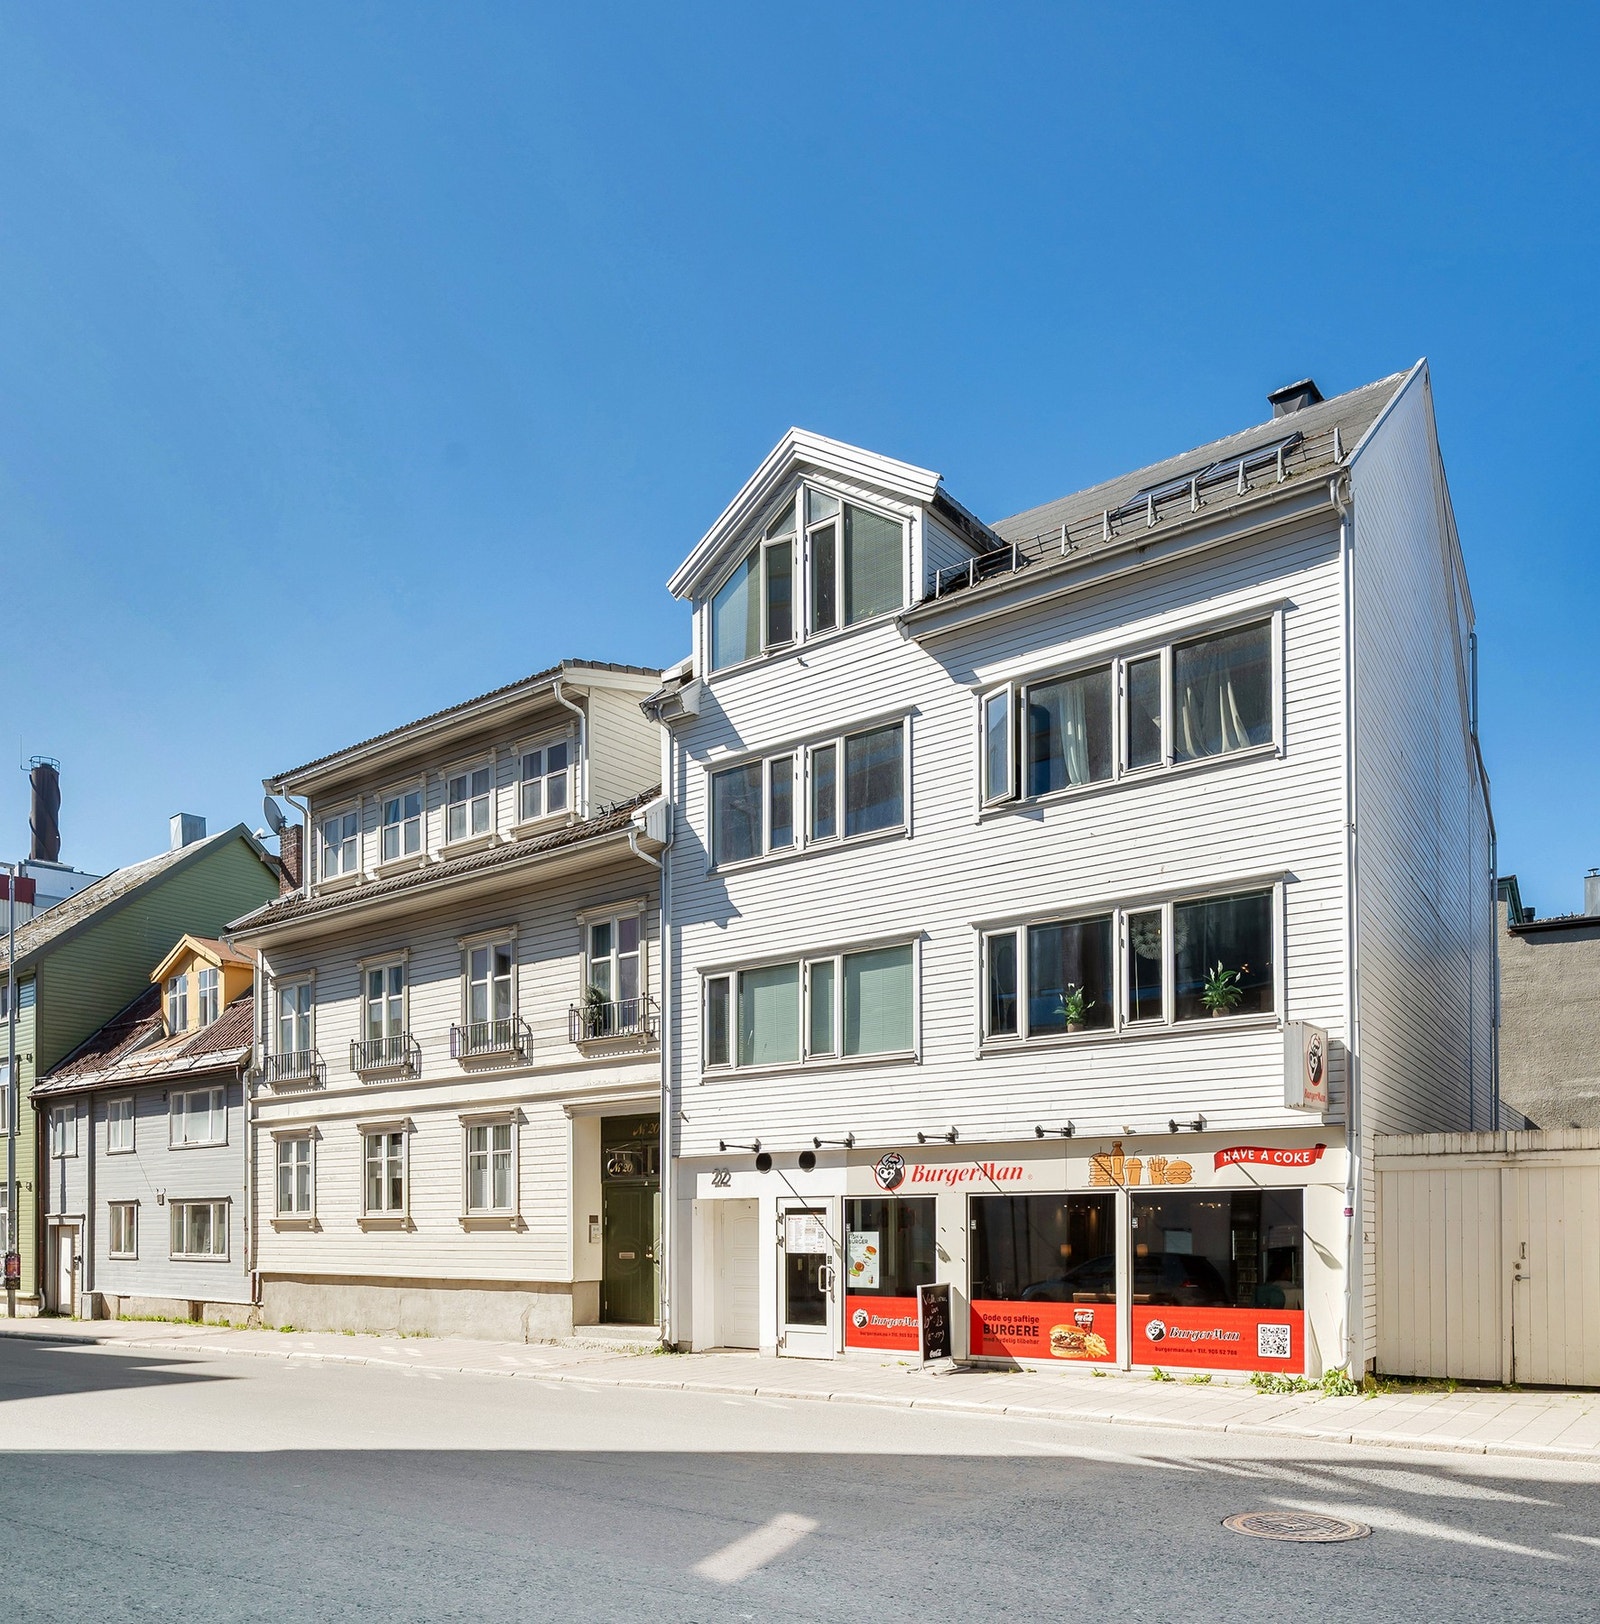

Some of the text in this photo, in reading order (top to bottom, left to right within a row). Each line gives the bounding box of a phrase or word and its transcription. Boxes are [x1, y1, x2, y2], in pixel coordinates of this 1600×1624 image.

[648, 1122, 660, 1135] 20
[1223, 1149, 1310, 1163] HAVE A COKE
[623, 1163, 633, 1173] 20
[911, 1163, 1023, 1187] BurgerMan
[711, 1167, 731, 1187] 22
[870, 1314, 919, 1329] BurgerMa
[982, 1313, 1040, 1324] Gode og saftige
[983, 1323, 1040, 1337] BURGERE
[1169, 1326, 1240, 1342] BurgerMan
